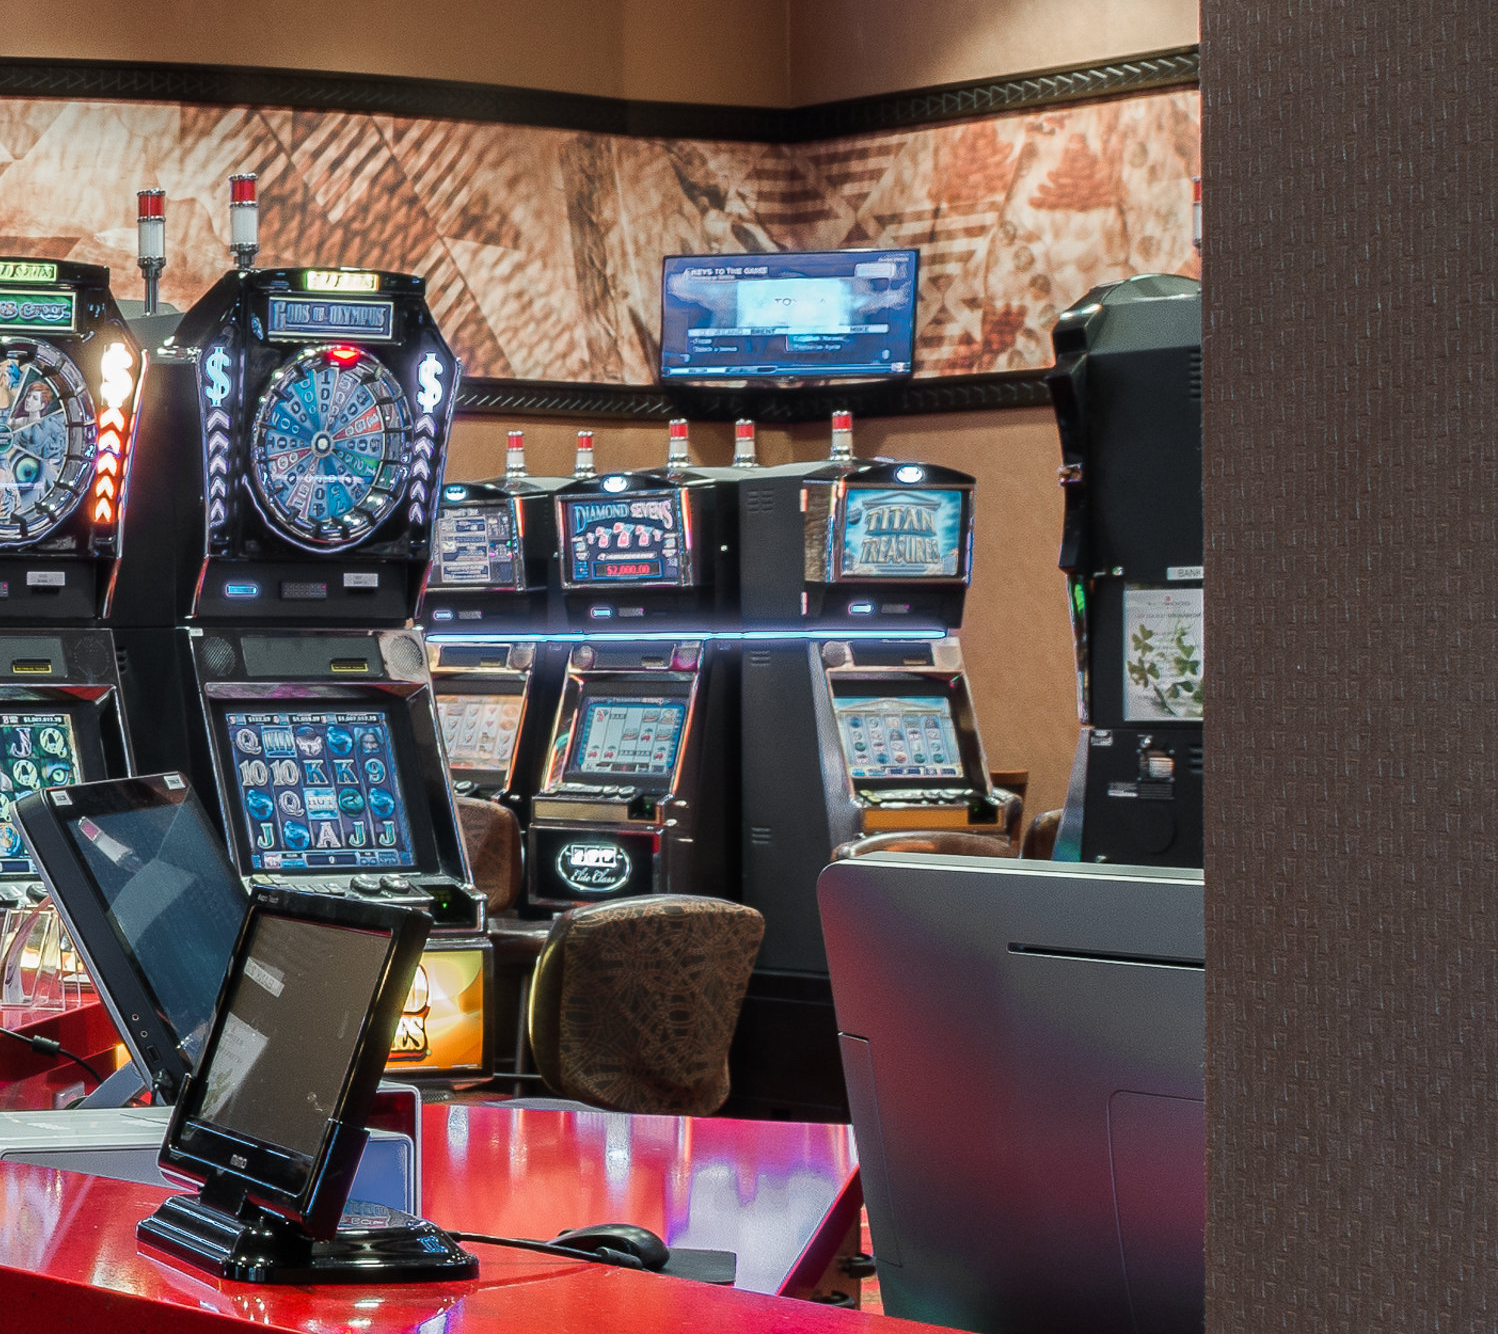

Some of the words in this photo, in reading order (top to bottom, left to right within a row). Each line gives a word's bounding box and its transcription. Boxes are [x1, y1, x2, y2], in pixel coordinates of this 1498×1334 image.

[273, 301, 310, 331] GODS
[329, 304, 386, 327] OLYMPUS
[574, 503, 629, 534] DIAMOND
[630, 499, 674, 530] SEVENS
[865, 506, 937, 533] TITAN
[859, 536, 941, 565] TREASURES
[10, 728, 32, 758] J
[39, 727, 68, 758] Q
[236, 728, 262, 755] Q
[12, 759, 41, 790] Q
[240, 759, 268, 786] 10
[270, 759, 299, 786] 10
[303, 759, 329, 784] K
[333, 759, 359, 784] K
[364, 758, 386, 784] 9
[279, 790, 305, 817] Q
[257, 823, 274, 849] J
[316, 821, 342, 848] A
[349, 821, 366, 847] J
[379, 821, 397, 846] J
